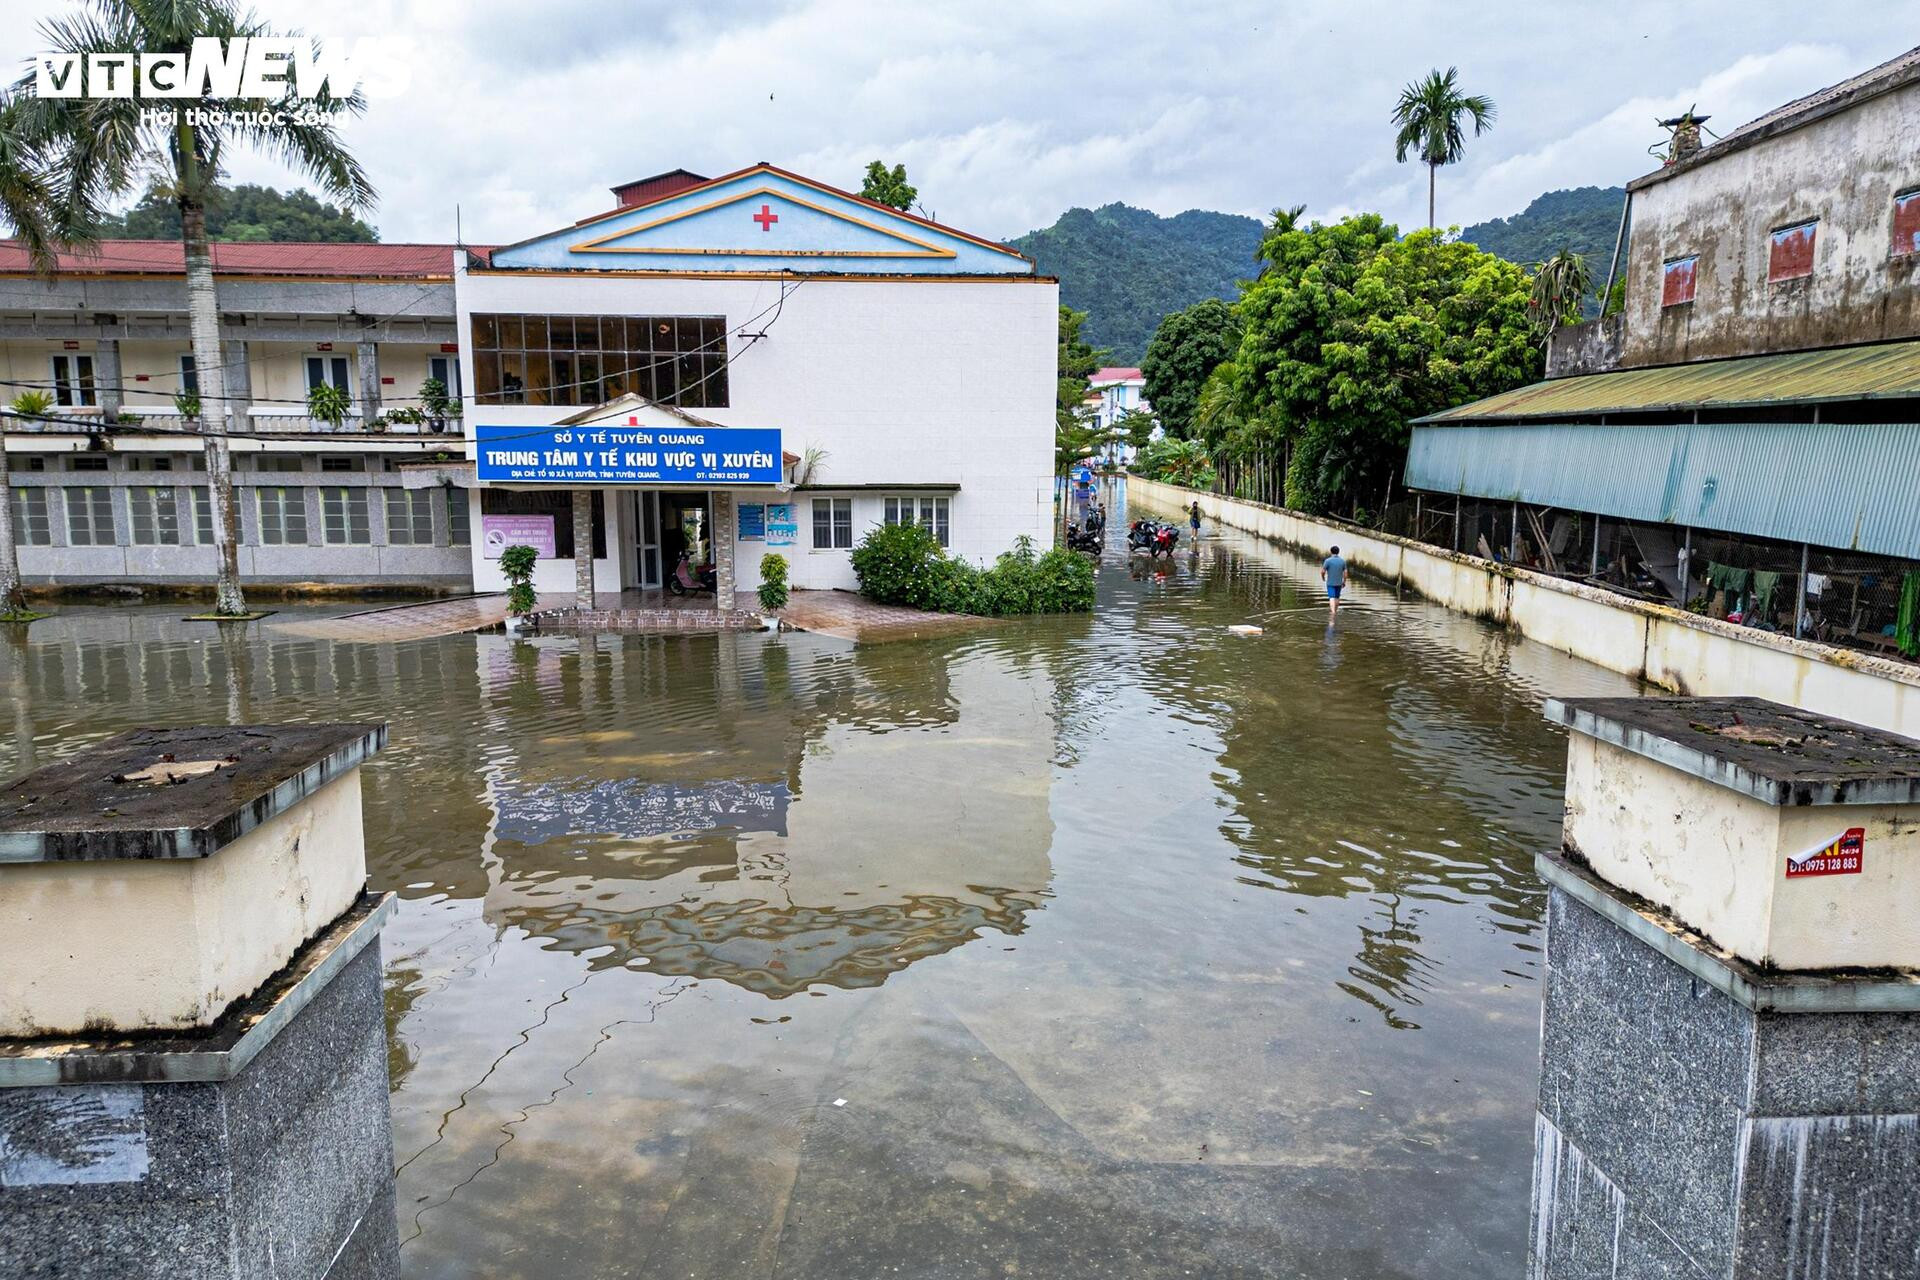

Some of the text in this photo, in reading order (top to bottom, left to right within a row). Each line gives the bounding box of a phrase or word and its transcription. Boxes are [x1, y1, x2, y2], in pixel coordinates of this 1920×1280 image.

[554, 430, 705, 445] SỞ Y TẾ TUYÊN QUANG
[486, 448, 773, 471] TRUNG TÂM Y TẾ KHU VỰC VỊ XUYÊN
[615, 470, 636, 479] TUYÊN
[1805, 860, 1825, 872] 0975
[1827, 858, 1841, 870] 128
[1843, 857, 1858, 870] 883
